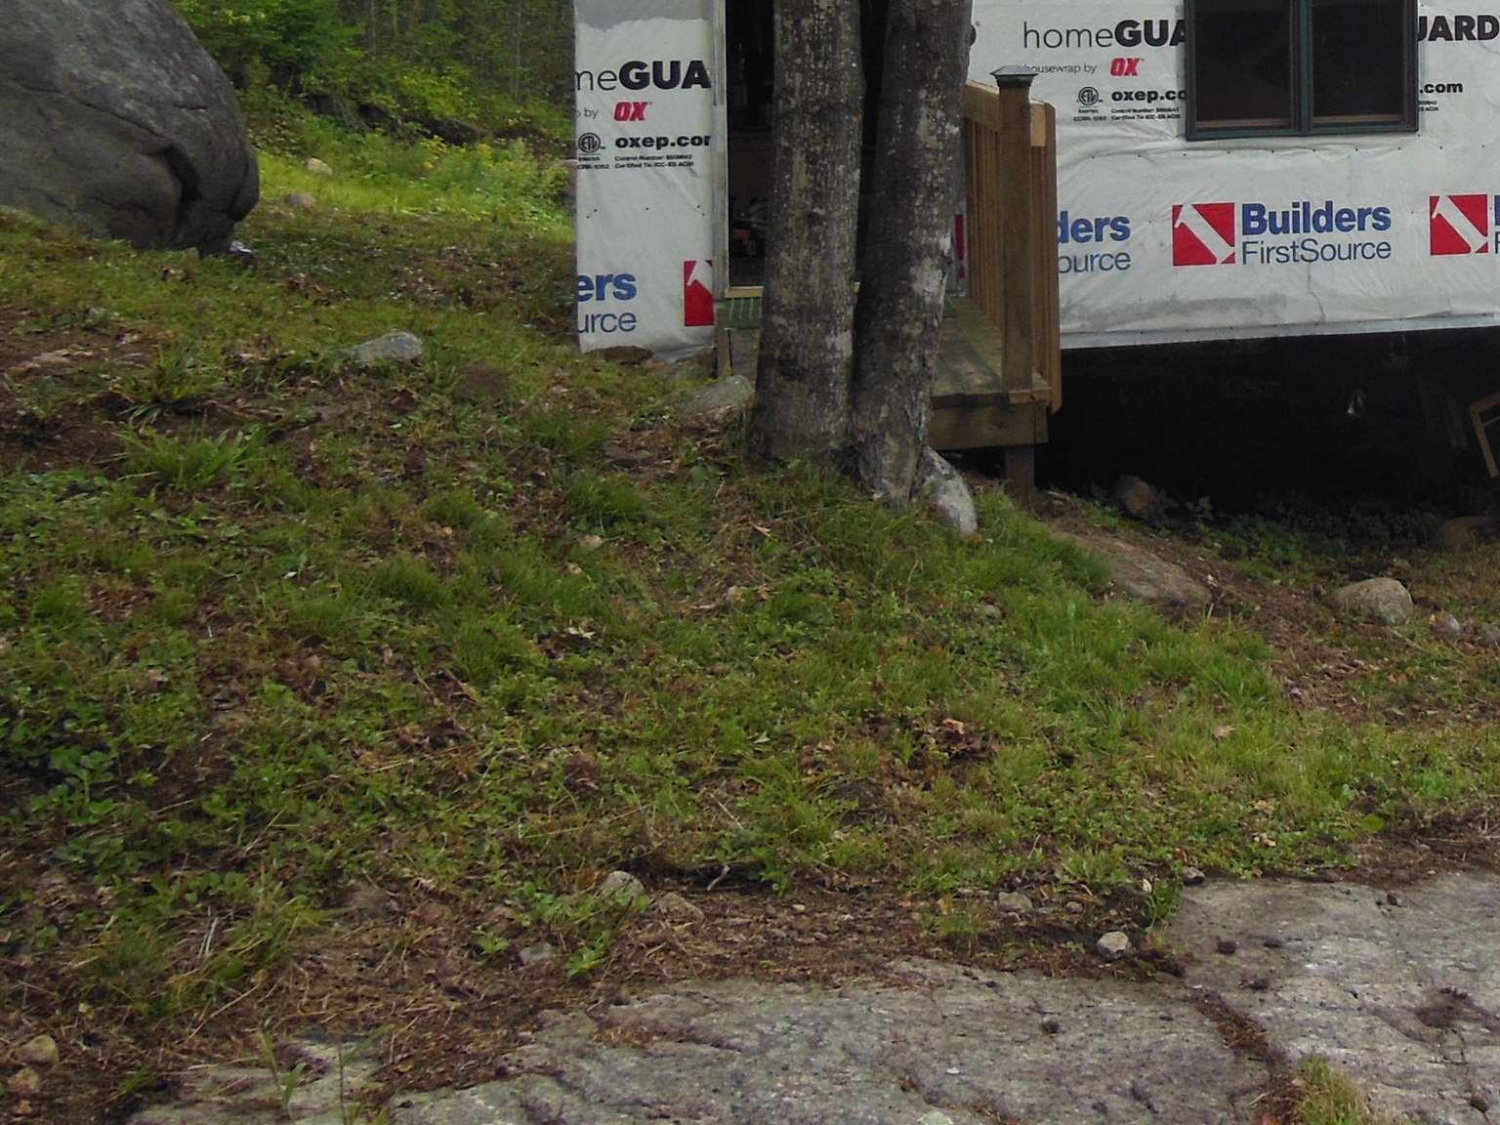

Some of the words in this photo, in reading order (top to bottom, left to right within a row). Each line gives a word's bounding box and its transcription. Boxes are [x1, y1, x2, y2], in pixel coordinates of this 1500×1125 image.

[1084, 64, 1097, 75] by
[1110, 58, 1140, 76] OX
[614, 101, 647, 121] OX
[1242, 201, 1391, 236] Builders
[1242, 238, 1391, 265] FirstSource
